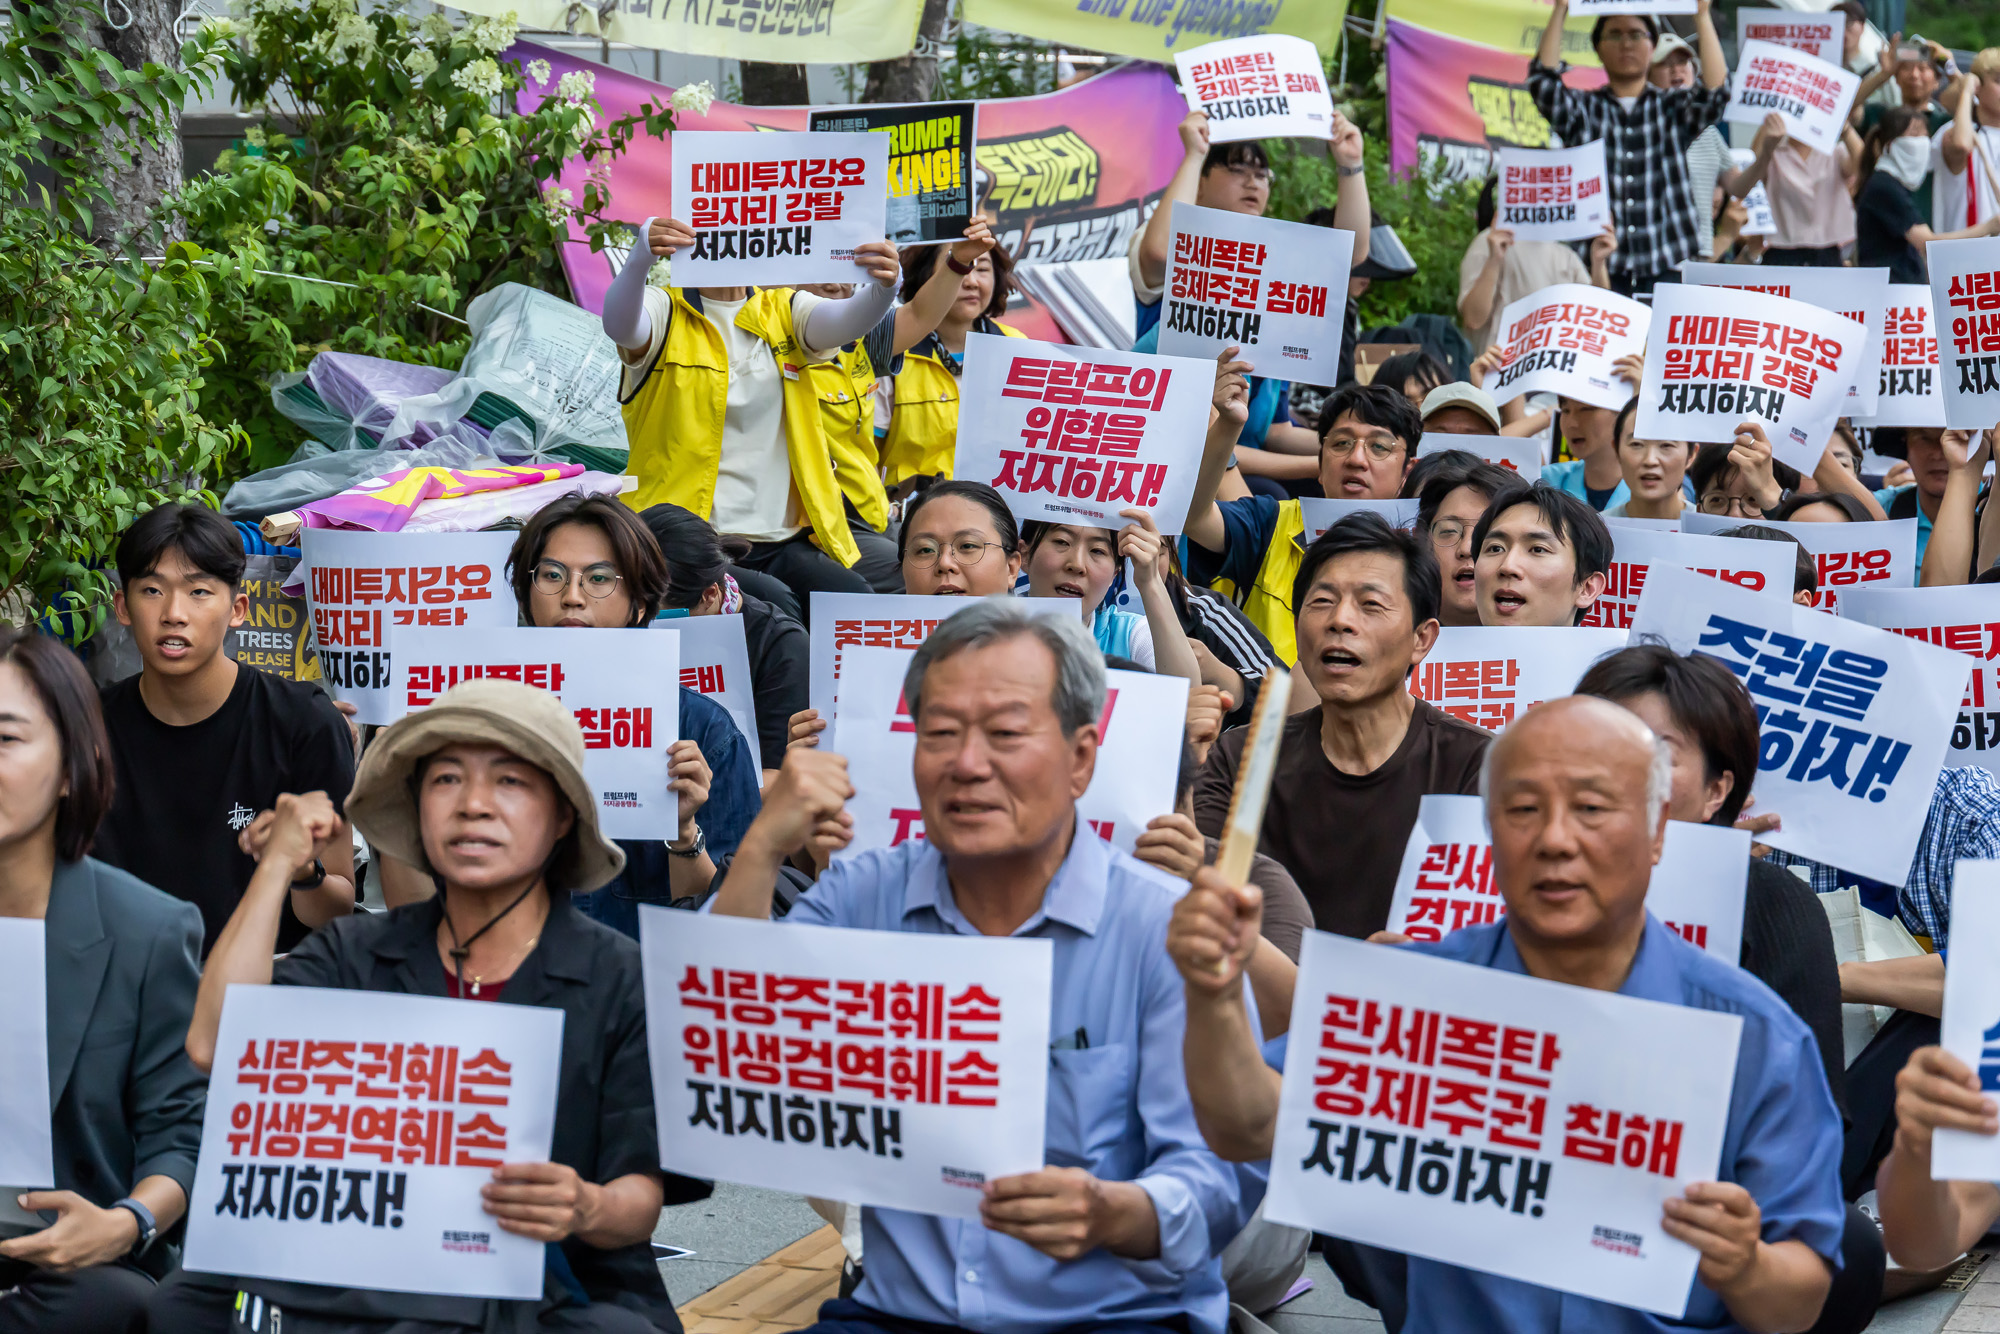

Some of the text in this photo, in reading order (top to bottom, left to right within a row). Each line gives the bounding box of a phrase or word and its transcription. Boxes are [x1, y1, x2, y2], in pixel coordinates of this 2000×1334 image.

[1191, 52, 1275, 80] 관세폭탄
[1196, 73, 1321, 101] 경제주권 침해
[1201, 96, 1289, 121] 저지하자!
[868, 115, 961, 155] RUMP!
[691, 158, 865, 193] 대미투자강요
[1506, 165, 1572, 184] 관세폭탄
[1506, 185, 1571, 203] 경제주권
[691, 191, 844, 228] 일자리 강탈
[1503, 205, 1576, 223] 저지하자!
[690, 225, 812, 261] 저지하자!
[1174, 232, 1267, 275] 관세폭탄
[1171, 266, 1328, 317] 경제주권 침해
[1167, 300, 1262, 345] 저지하자!
[1508, 304, 1630, 344] 대미투자강요
[1667, 316, 1842, 372] 대미투자강요
[1500, 327, 1609, 368] 일자리 강탈
[1002, 357, 1172, 412] 트럼프의
[1494, 350, 1577, 390] 저지하자!
[1664, 349, 1818, 399] 일자리 강탈
[1658, 383, 1786, 423] 저지하자!
[1021, 407, 1146, 458] 위협을
[992, 450, 1168, 507] 저지하자!
[311, 564, 492, 605] 대미투자강요
[236, 630, 293, 649] TREES
[314, 608, 382, 647] 일자리
[237, 651, 291, 667] PLEASE
[1691, 614, 1888, 722] 주권을
[574, 707, 652, 749] 침해
[1757, 704, 1912, 803] 하자!
[1405, 897, 1506, 942] 경제
[678, 965, 1000, 1041] 식량주권훼손
[1320, 994, 1561, 1089] 관세폭탄
[237, 1039, 512, 1106] 식량주권훼손
[683, 1025, 999, 1106] 위생검역훼손
[227, 1101, 507, 1168] 위생검역훼손
[687, 1080, 903, 1159] 저지하자!
[1313, 1057, 1684, 1178] 경제주권 침해
[1302, 1118, 1552, 1218] 저지하자!
[215, 1164, 407, 1227] 저지하자!
